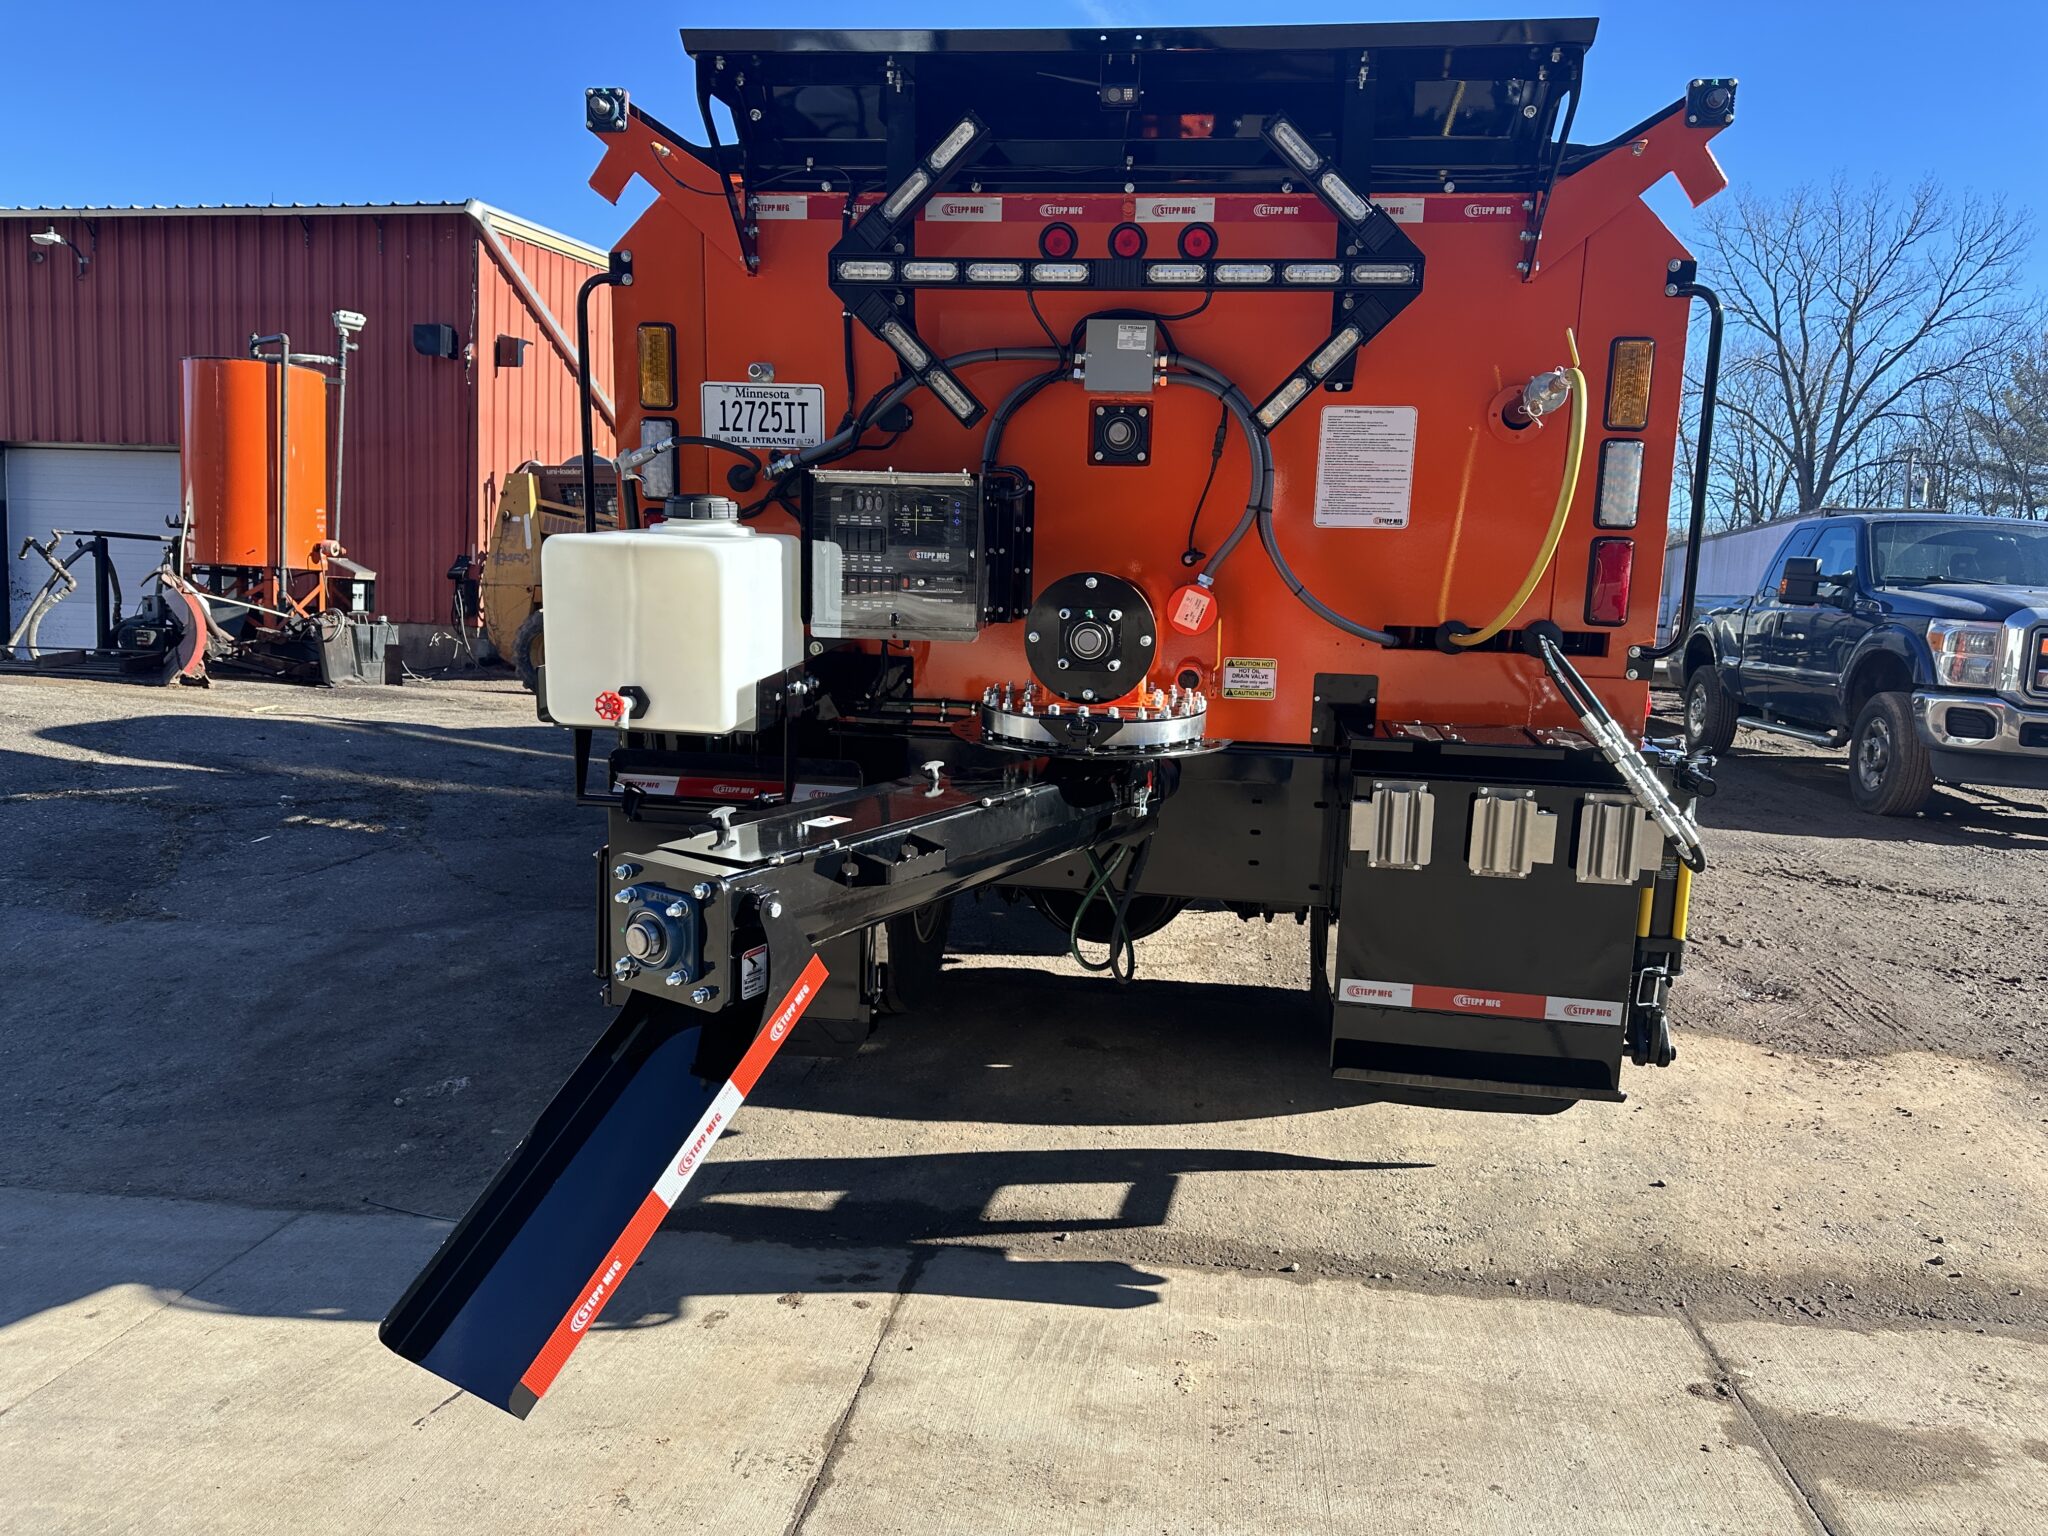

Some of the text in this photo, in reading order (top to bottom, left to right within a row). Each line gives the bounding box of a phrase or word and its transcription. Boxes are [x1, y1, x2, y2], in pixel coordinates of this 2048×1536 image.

[776, 204, 790, 212] MFG
[950, 205, 984, 214] STEPP MFG
[1047, 206, 1083, 215] STEPP MFG
[1160, 206, 1196, 215] STEPP MFG
[1261, 206, 1299, 215] STEPP MFG
[1389, 206, 1405, 215] MFG
[1472, 206, 1512, 215] STEPP MFG
[735, 387, 790, 399] Minnesota
[719, 400, 809, 433] 12725IT
[752, 437, 796, 445] INTRANSIT
[916, 551, 950, 560] STEPP MFG
[1355, 987, 1393, 998] STEPP MFG
[1461, 997, 1501, 1008] STEPP MFG
[777, 984, 811, 1032] STEPP MFG
[1572, 1006, 1612, 1017] STEPP MFG
[684, 1112, 723, 1166] STEPP MFG
[577, 1259, 623, 1320] STEPP MFG
